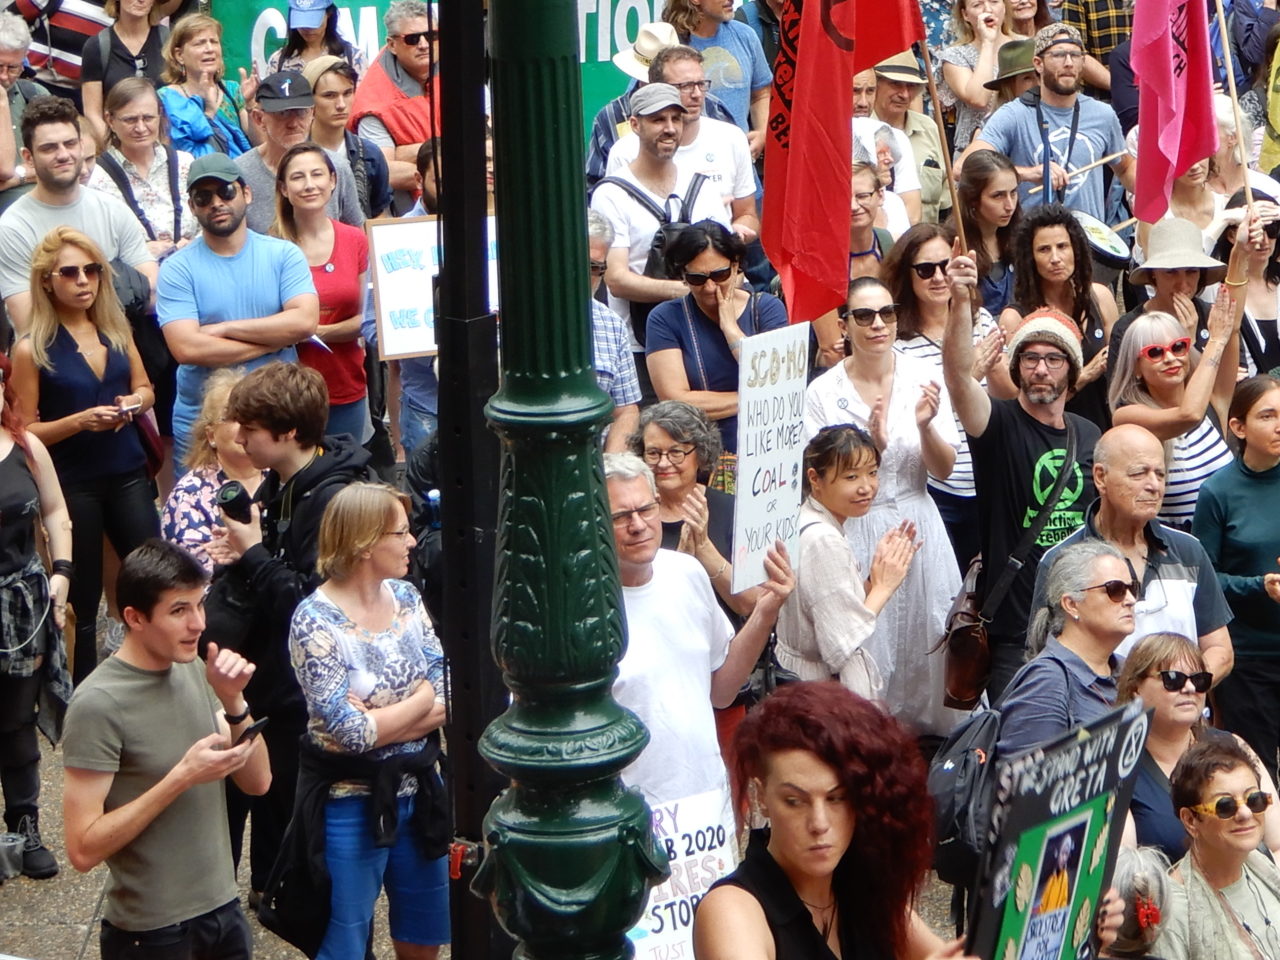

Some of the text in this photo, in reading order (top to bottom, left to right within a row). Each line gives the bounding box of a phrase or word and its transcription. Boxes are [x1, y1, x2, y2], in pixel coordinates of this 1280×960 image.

[389, 307, 421, 330] WE
[746, 389, 804, 428] WHO DO YOU
[746, 420, 804, 458] LIKE MORE?
[752, 462, 786, 498] COAL
[766, 498, 777, 513] OR
[744, 503, 801, 554] YOUR KIDS?
[1083, 724, 1118, 765] WITH
[1050, 758, 1108, 816] GRETA
[681, 824, 726, 857] 2020
